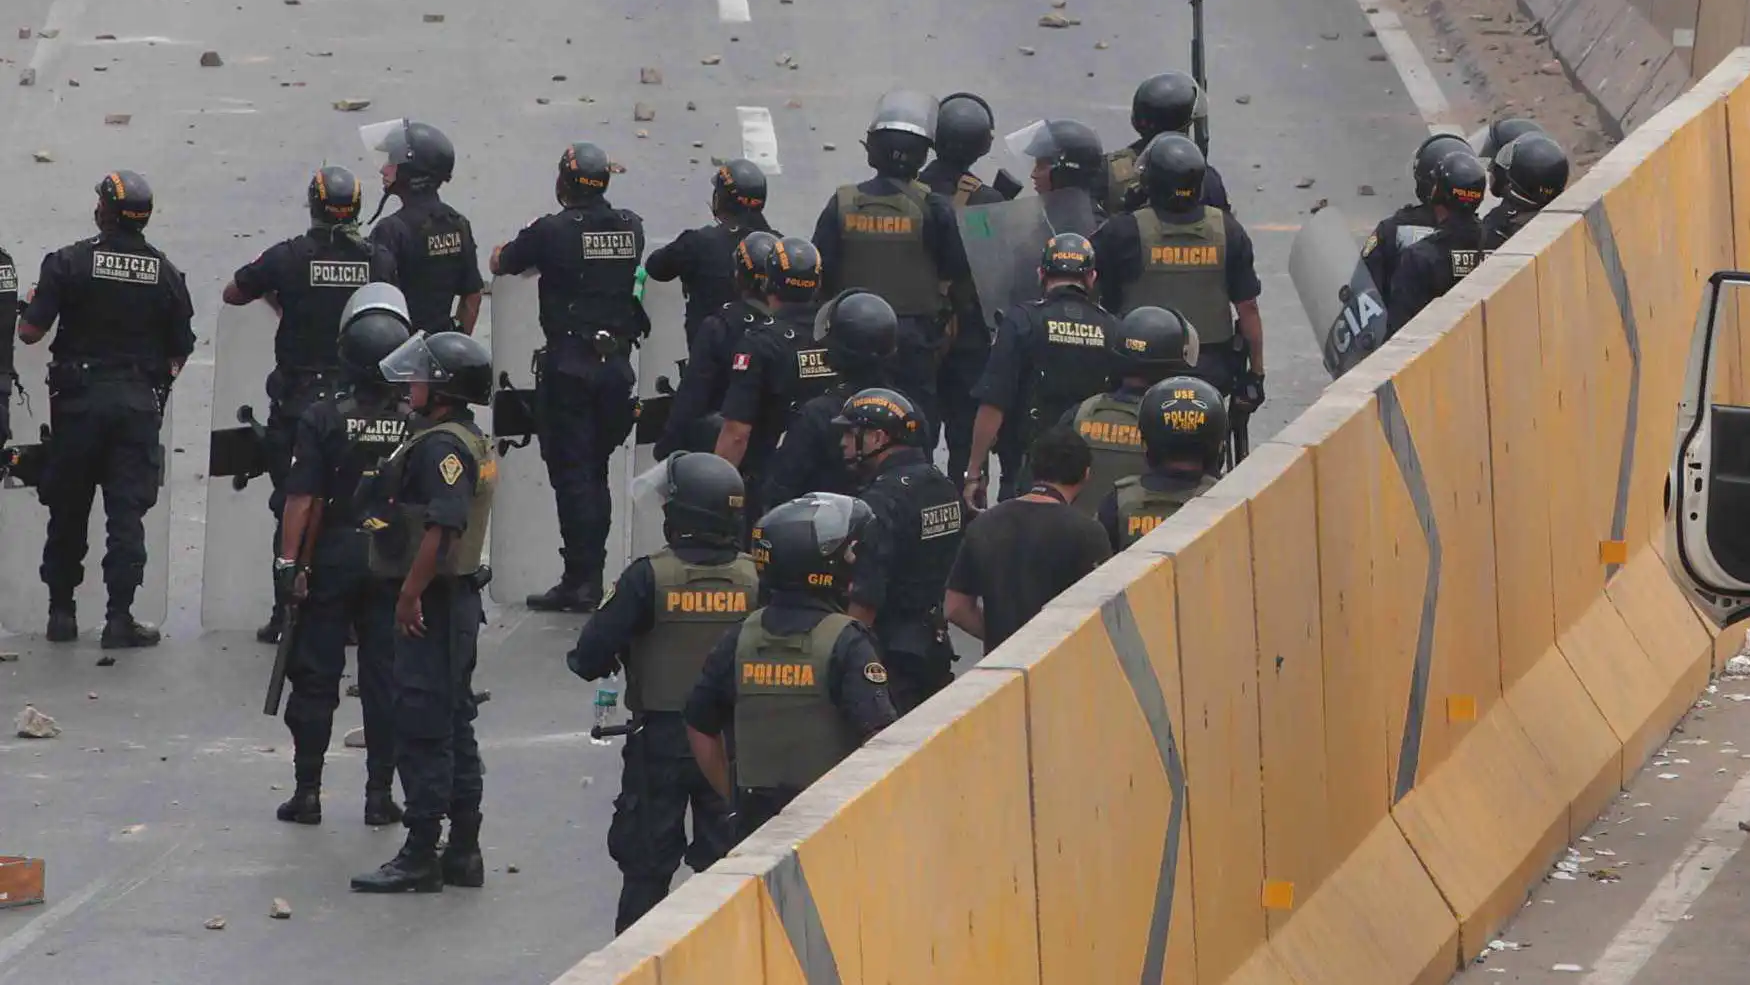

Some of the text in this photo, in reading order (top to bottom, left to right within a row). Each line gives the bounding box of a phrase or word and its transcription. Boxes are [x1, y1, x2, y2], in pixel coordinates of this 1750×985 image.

[845, 213, 912, 233] POLICIA
[428, 232, 461, 250] POLICIA
[585, 235, 632, 248] POLICIA
[96, 255, 156, 273] POLICIA
[1151, 246, 1217, 265] POLICIA
[313, 264, 367, 282] POLICIA
[1048, 320, 1105, 339] POLICIA
[1334, 292, 1384, 354] CIA
[1125, 337, 1148, 352] USE
[1174, 389, 1195, 399] USE
[1163, 410, 1205, 426] POLICIA
[808, 573, 833, 586] GIR
[667, 591, 747, 613] POLICIA
[743, 663, 815, 686] POLICIA
